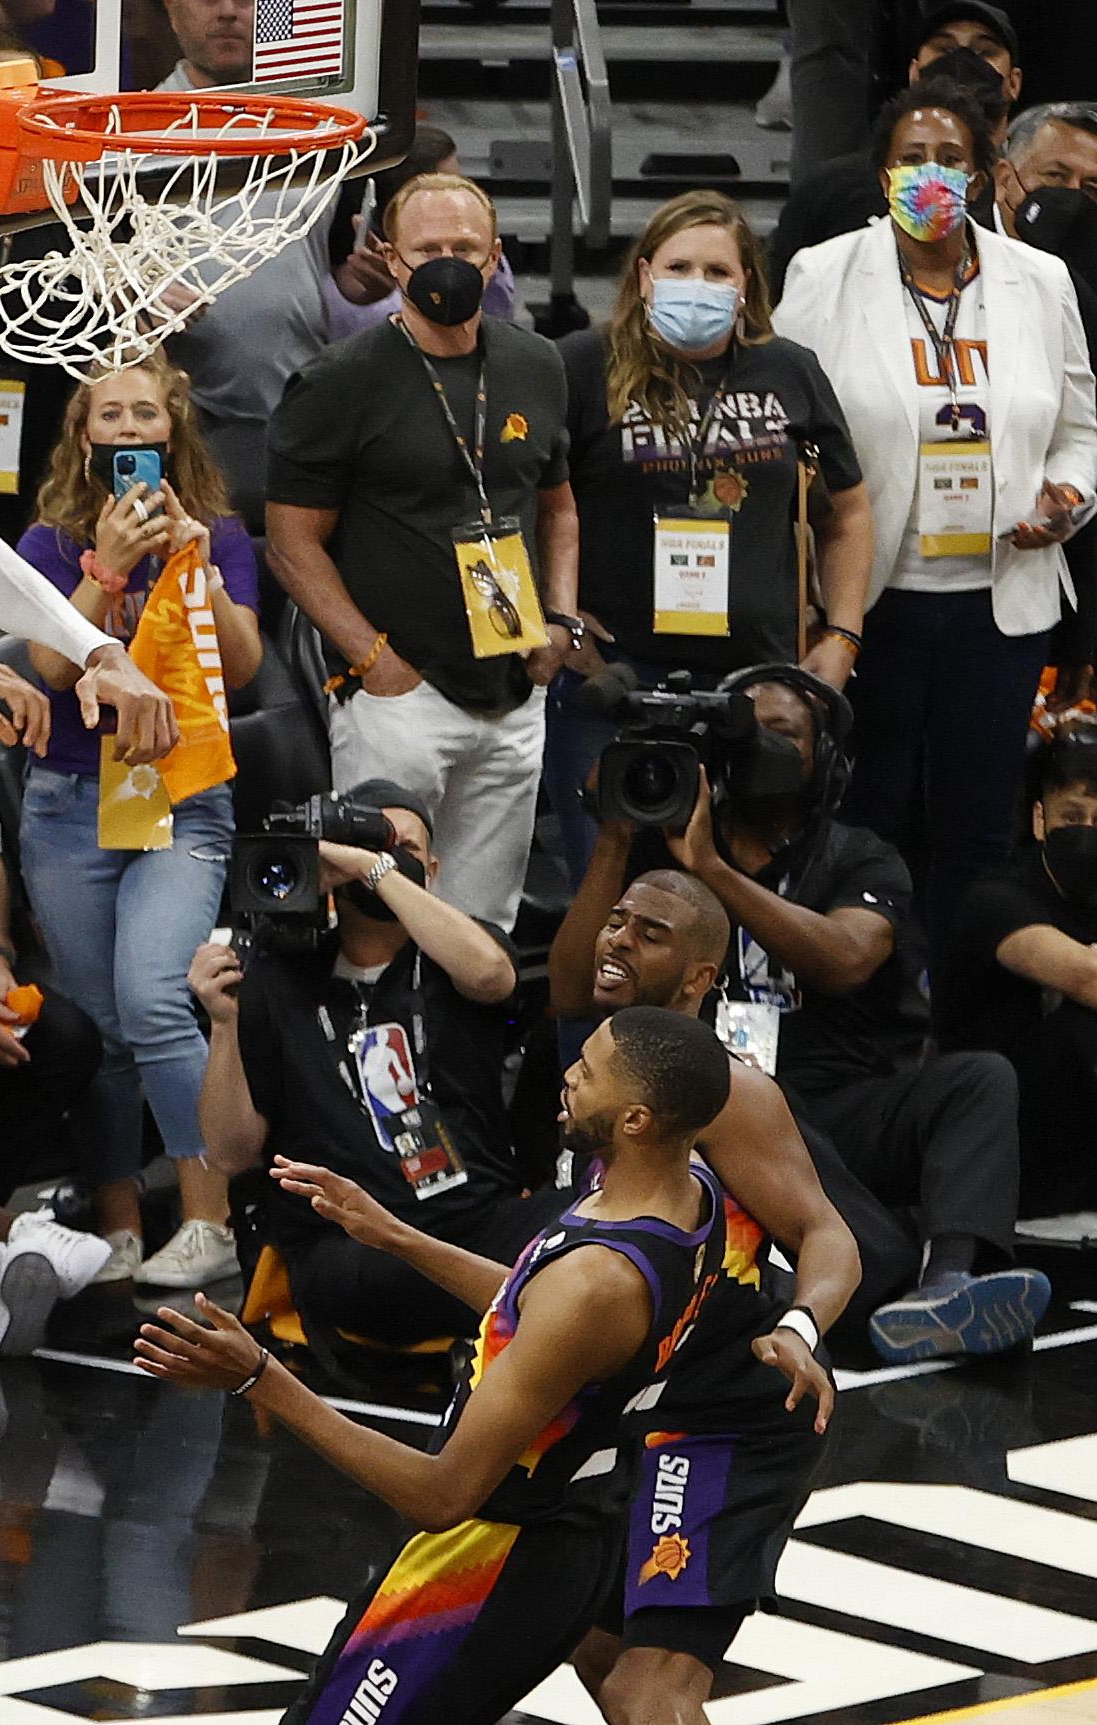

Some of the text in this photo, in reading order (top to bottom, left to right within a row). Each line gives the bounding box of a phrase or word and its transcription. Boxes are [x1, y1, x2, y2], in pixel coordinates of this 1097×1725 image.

[715, 392, 788, 420] NBA
[642, 455, 726, 473] PHONIX
[651, 1453, 690, 1534] SUNS
[339, 1658, 399, 1725] UNS
